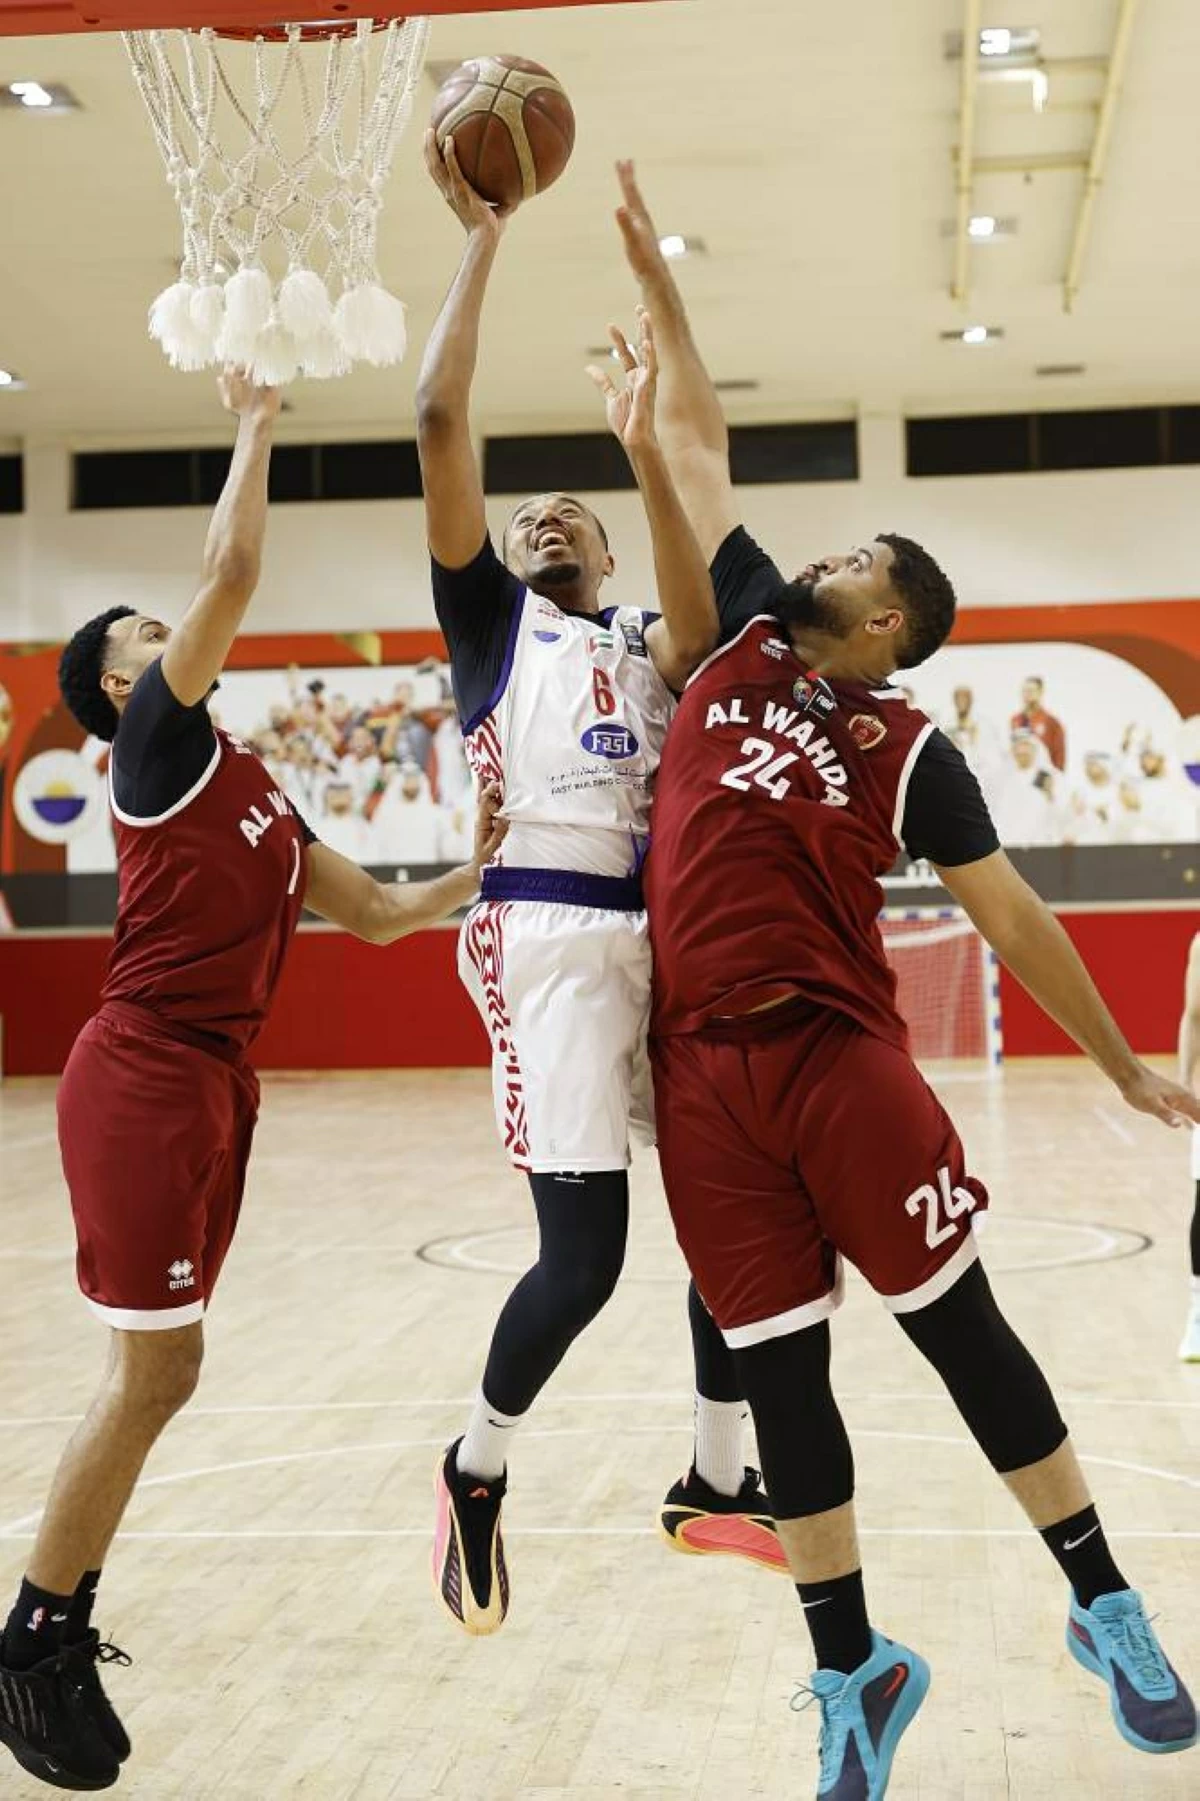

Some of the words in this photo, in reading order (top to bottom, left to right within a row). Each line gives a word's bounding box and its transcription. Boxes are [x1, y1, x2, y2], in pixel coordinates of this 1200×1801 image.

[593, 666, 616, 716] 6
[705, 698, 749, 729] AL
[762, 700, 850, 807] WAHDA
[719, 737, 800, 800] 24
[239, 805, 274, 848] AL
[904, 1166, 977, 1250] 24
